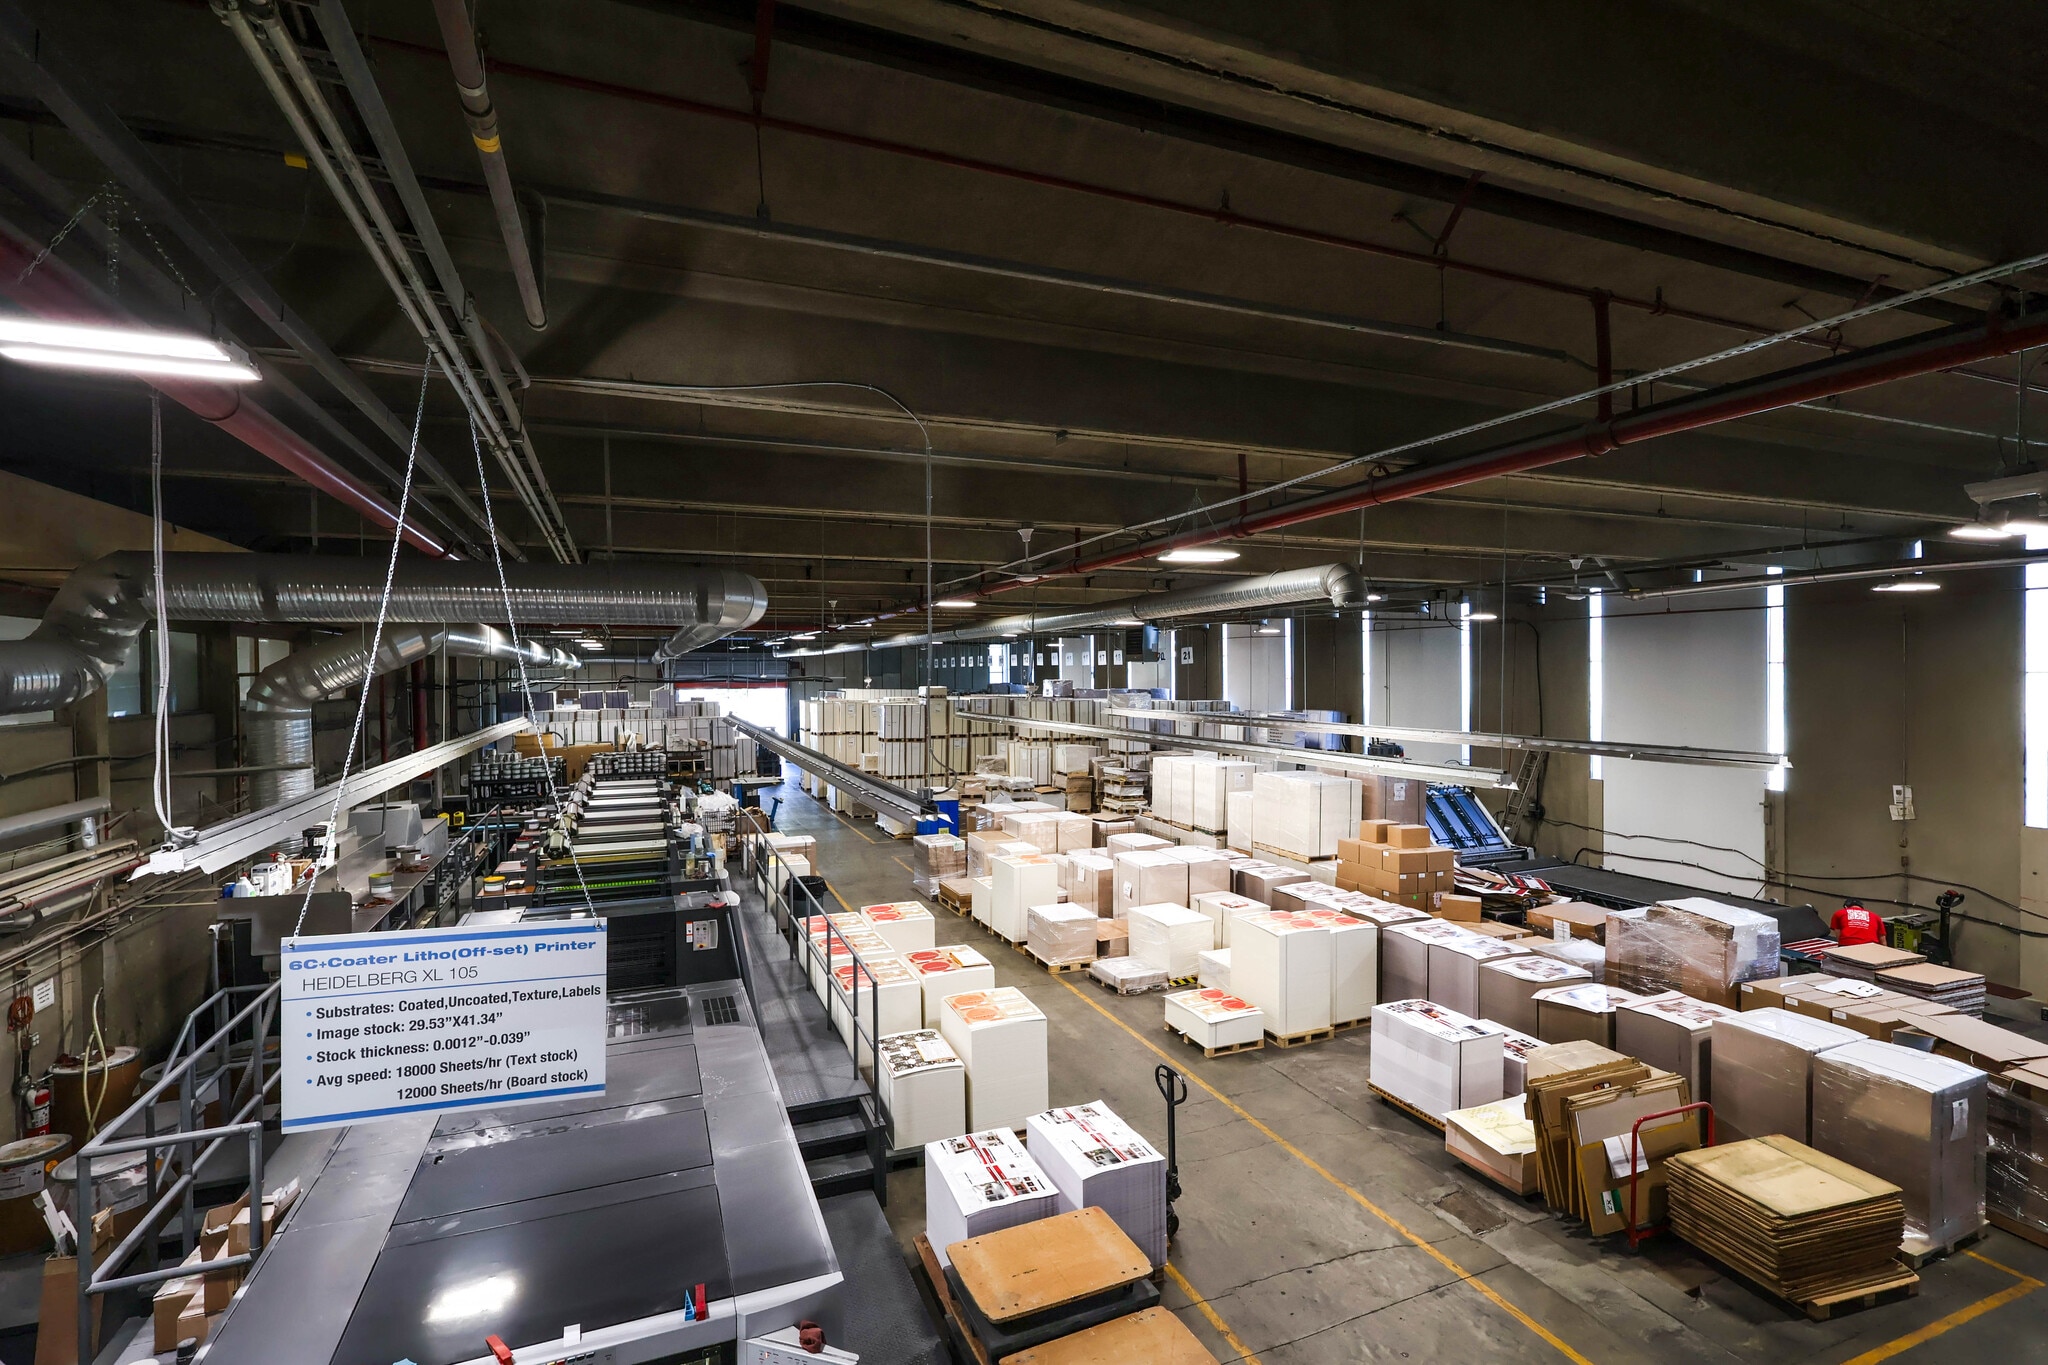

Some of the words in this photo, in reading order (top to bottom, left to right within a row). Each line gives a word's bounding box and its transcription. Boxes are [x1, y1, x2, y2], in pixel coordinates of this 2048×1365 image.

[1182, 651, 1192, 661] 21
[288, 955, 398, 971] 6C+Coater
[403, 944, 529, 962] Litho(Off-set)
[534, 941, 597, 953] Printer
[302, 970, 417, 991] HEIDELBERG
[422, 968, 444, 982] XL
[450, 966, 478, 980] 105
[316, 1003, 394, 1020] Substrates:
[398, 985, 601, 1012] Coated,Uncoated,Texture,Labels
[316, 1027, 360, 1040] Image
[363, 1022, 405, 1036] stock:
[408, 1012, 503, 1032] 29.53”X41.34”
[316, 1048, 356, 1063] Stock
[360, 1043, 429, 1059] thickness:
[433, 1031, 531, 1051] 0.0012”-0.039”
[316, 1075, 343, 1087] Avg
[347, 1068, 392, 1085] speed:
[396, 1063, 436, 1078] 18000
[439, 1057, 502, 1074] Sheets/hr
[505, 1053, 537, 1069] (Text
[540, 1049, 578, 1062] stock)
[397, 1085, 437, 1100] 12000
[440, 1079, 503, 1095] Sheets/hr
[506, 1073, 548, 1090] (Board
[551, 1069, 588, 1083] stock)
